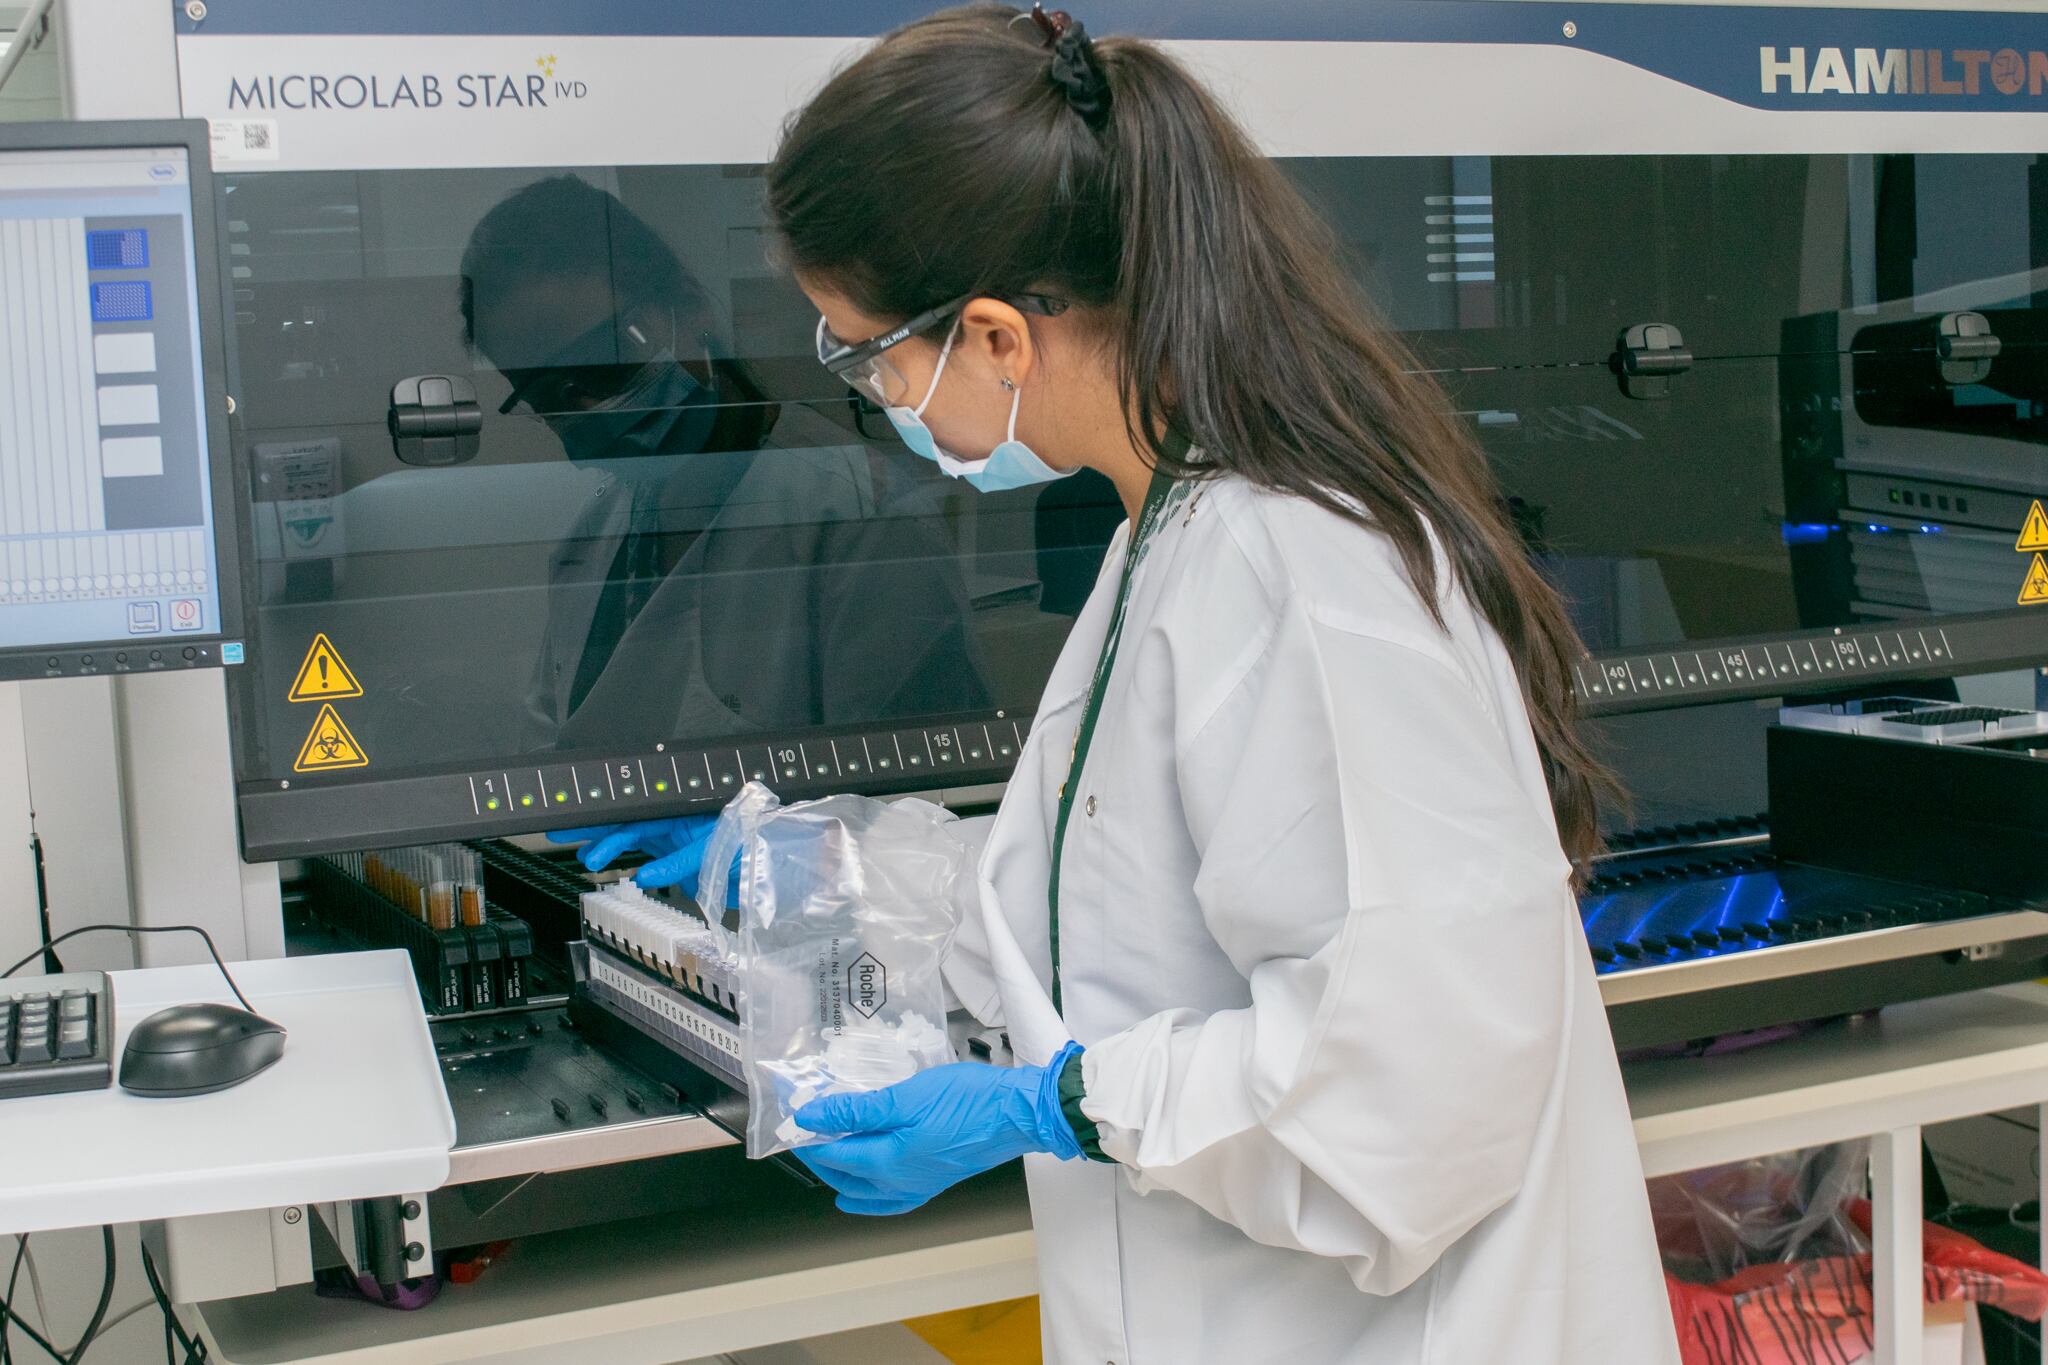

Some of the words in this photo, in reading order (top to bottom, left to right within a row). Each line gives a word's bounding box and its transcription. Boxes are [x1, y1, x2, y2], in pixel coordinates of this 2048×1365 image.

[228, 74, 443, 110] MICROLAB
[457, 73, 548, 109] STAR
[554, 81, 587, 99] IVD
[1609, 665, 1626, 679] 40
[1727, 654, 1743, 667] 45
[1838, 642, 1855, 654] 50
[484, 778, 494, 793] 1
[620, 765, 631, 779] 5
[778, 749, 796, 763] 10
[934, 733, 951, 747] 15
[831, 938, 839, 958] Mat.
[859, 964, 876, 1007] Roche
[643, 990, 648, 1003] 9
[664, 1002, 670, 1015] 12
[686, 1014, 692, 1028] 15
[693, 1019, 700, 1032] 16
[701, 1023, 707, 1036] 17
[709, 1027, 715, 1041] 18
[717, 1032, 723, 1046] 19
[725, 1036, 732, 1051] 20
[733, 1040, 739, 1054] 21
[832, 980, 842, 1037] 3137040001
